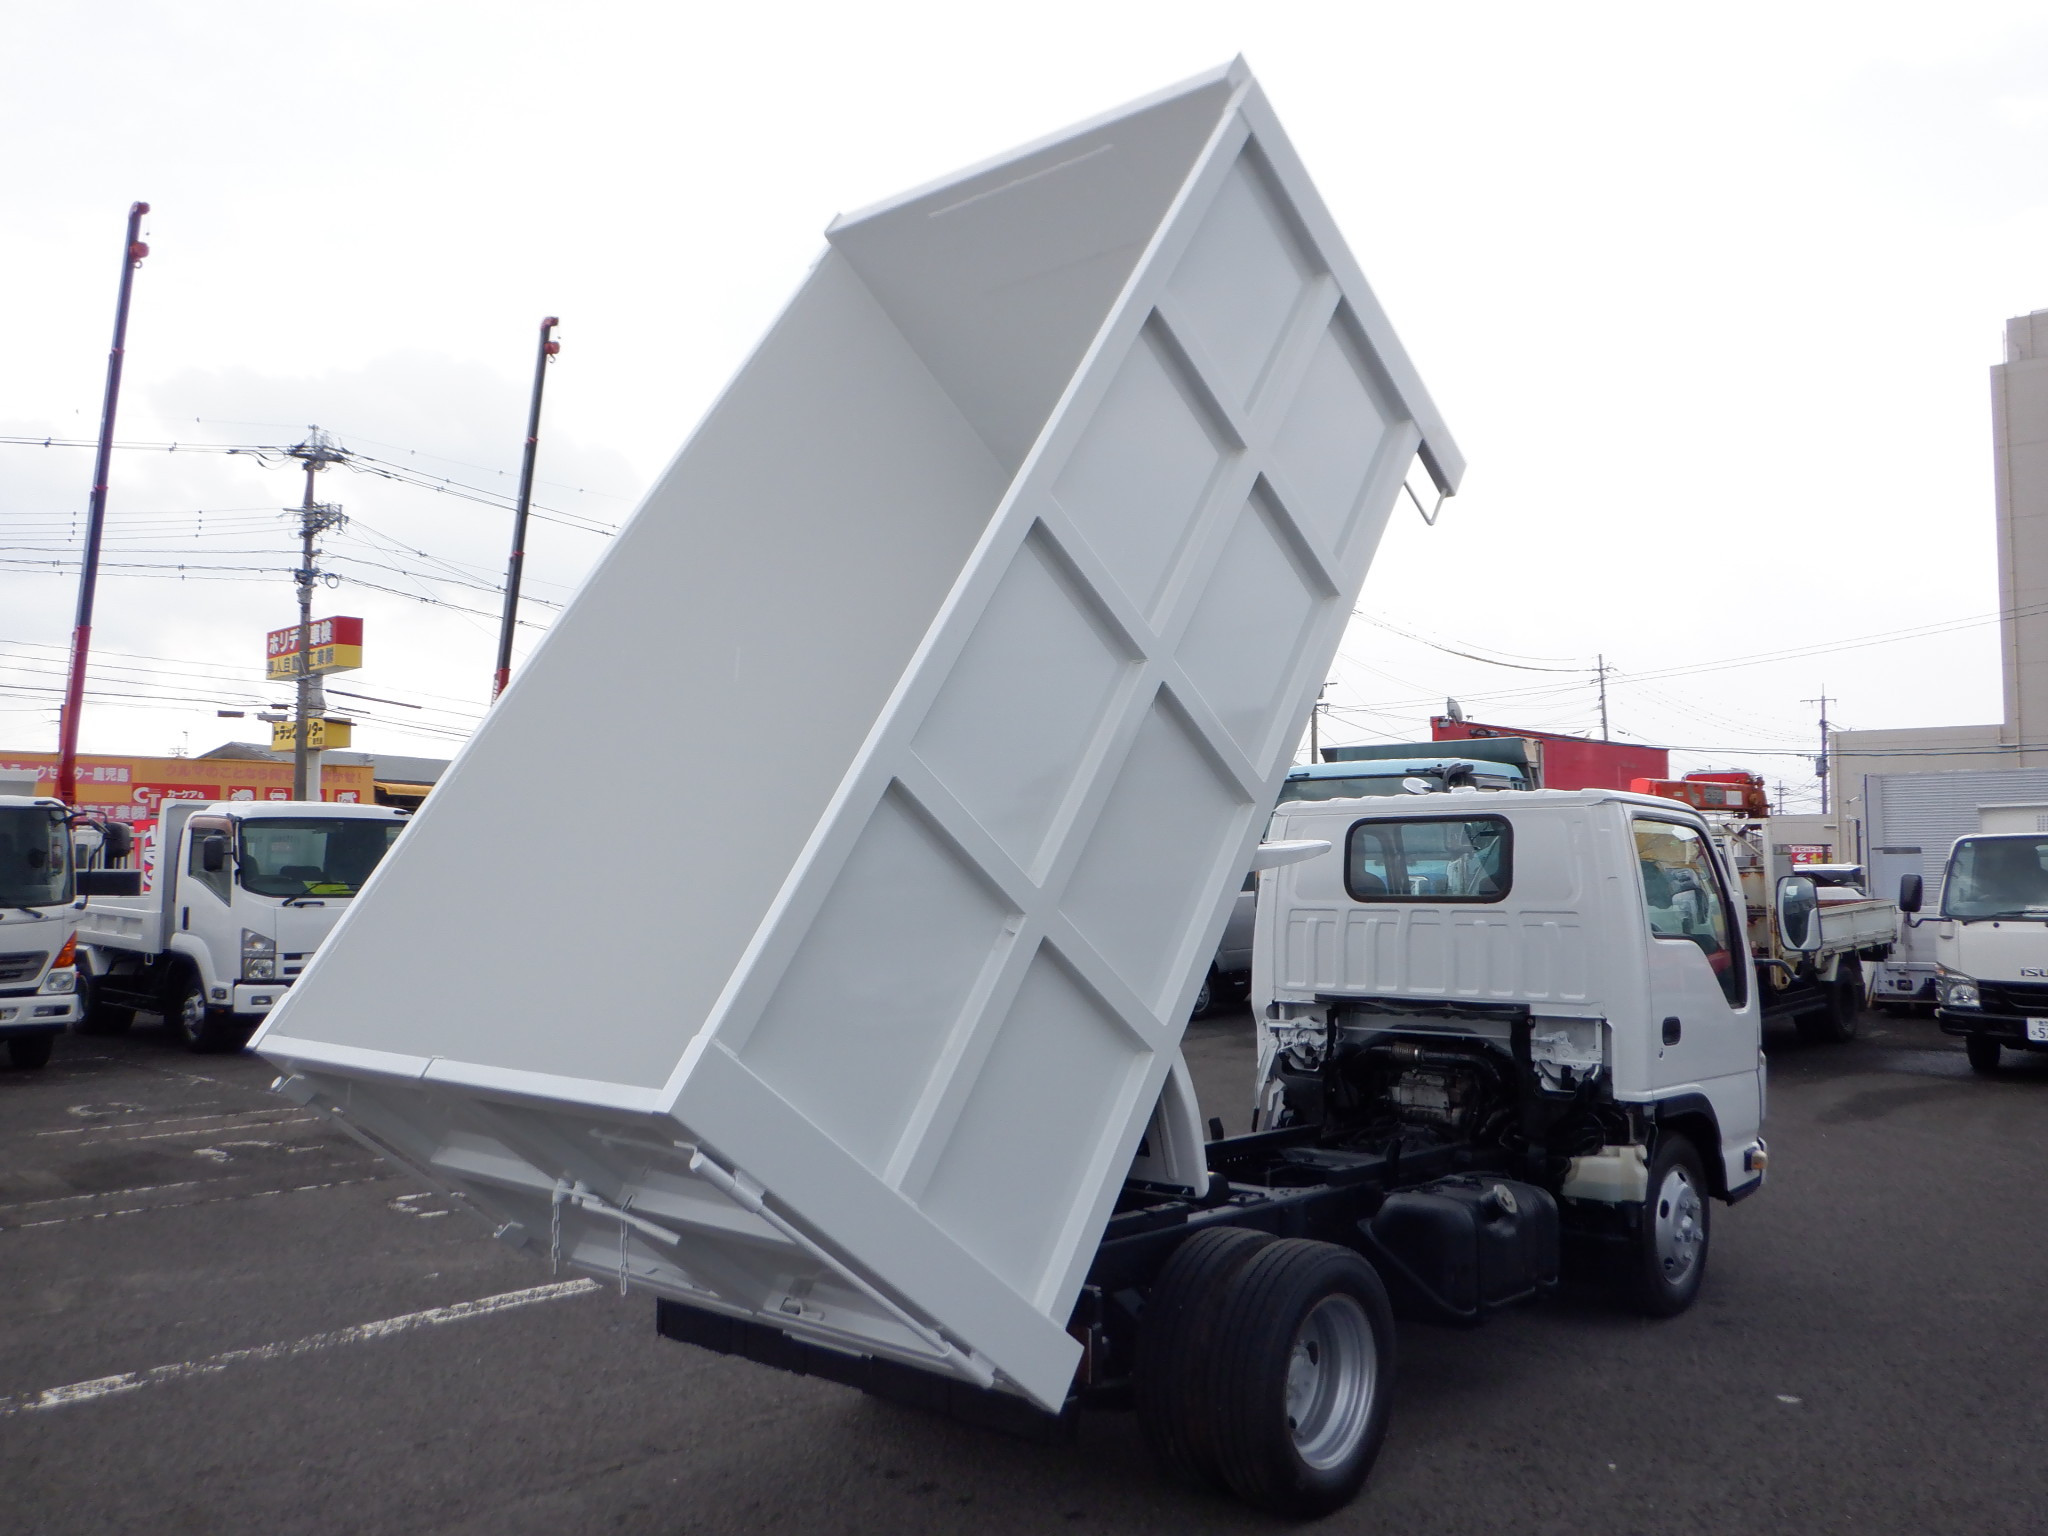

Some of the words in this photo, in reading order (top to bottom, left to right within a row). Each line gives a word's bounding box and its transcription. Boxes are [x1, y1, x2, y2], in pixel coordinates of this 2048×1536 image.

[269, 620, 333, 655] ホリデ車検
